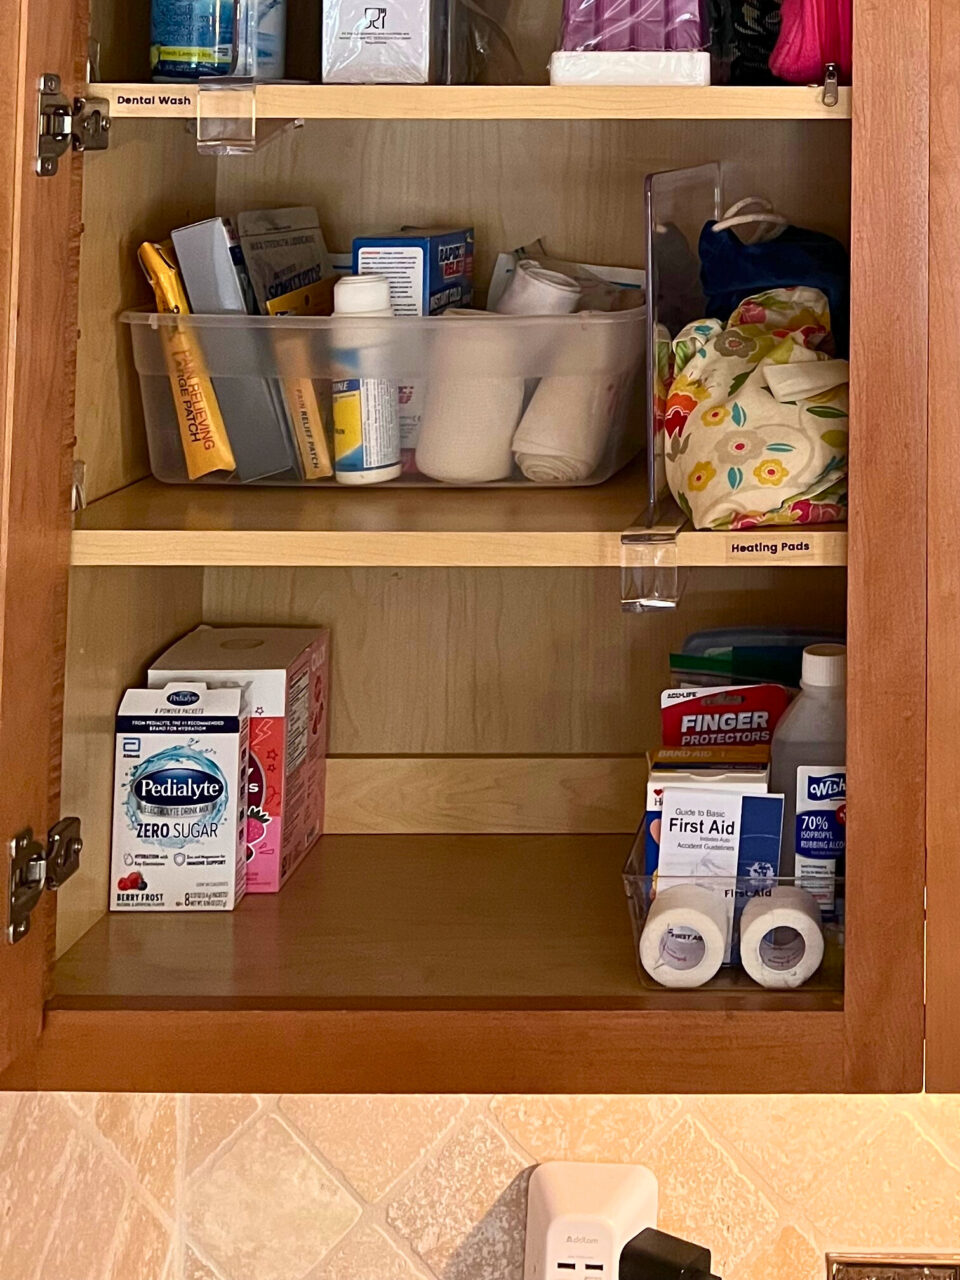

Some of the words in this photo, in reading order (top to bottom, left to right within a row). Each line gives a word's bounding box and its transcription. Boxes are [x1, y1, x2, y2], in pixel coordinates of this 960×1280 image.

[117, 95, 155, 105] Dental
[158, 95, 191, 105] Wash
[181, 350, 196, 381] PAIN
[189, 382, 216, 451] RELIEVING
[183, 399, 202, 443] PATCH
[300, 410, 312, 443] RELIEF
[308, 439, 320, 469] PATCH
[731, 542, 778, 554] Heating
[781, 541, 810, 551] Pads
[169, 695, 198, 703] Pedialyte
[681, 711, 769, 733] FINGER
[681, 730, 770, 746] PROTECTORS
[657, 749, 712, 759] BAND-AID
[140, 778, 220, 799] Pedialyte
[143, 806, 179, 816] ELECTROLYTE
[180, 807, 198, 816] DRINK
[198, 806, 209, 814] MIX
[675, 808, 696, 817] Guide
[697, 808, 705, 817] to
[706, 809, 726, 818] Basic
[669, 817, 705, 834] First
[708, 819, 735, 836] Aid
[801, 815, 828, 830] 70%
[136, 823, 170, 839] ZERO
[173, 822, 218, 838] SUGAR
[801, 831, 833, 839] ISOPROPYL
[677, 842, 702, 850] Accident
[704, 843, 735, 851] Guidelines
[801, 840, 828, 849] RUBBING
[829, 840, 845, 849] ALCO
[117, 893, 140, 902] BERRY
[141, 893, 164, 902] FROST
[724, 889, 748, 898] First
[754, 888, 772, 898] Aid
[184, 892, 190, 907] 8
[672, 932, 691, 941] FIRST
